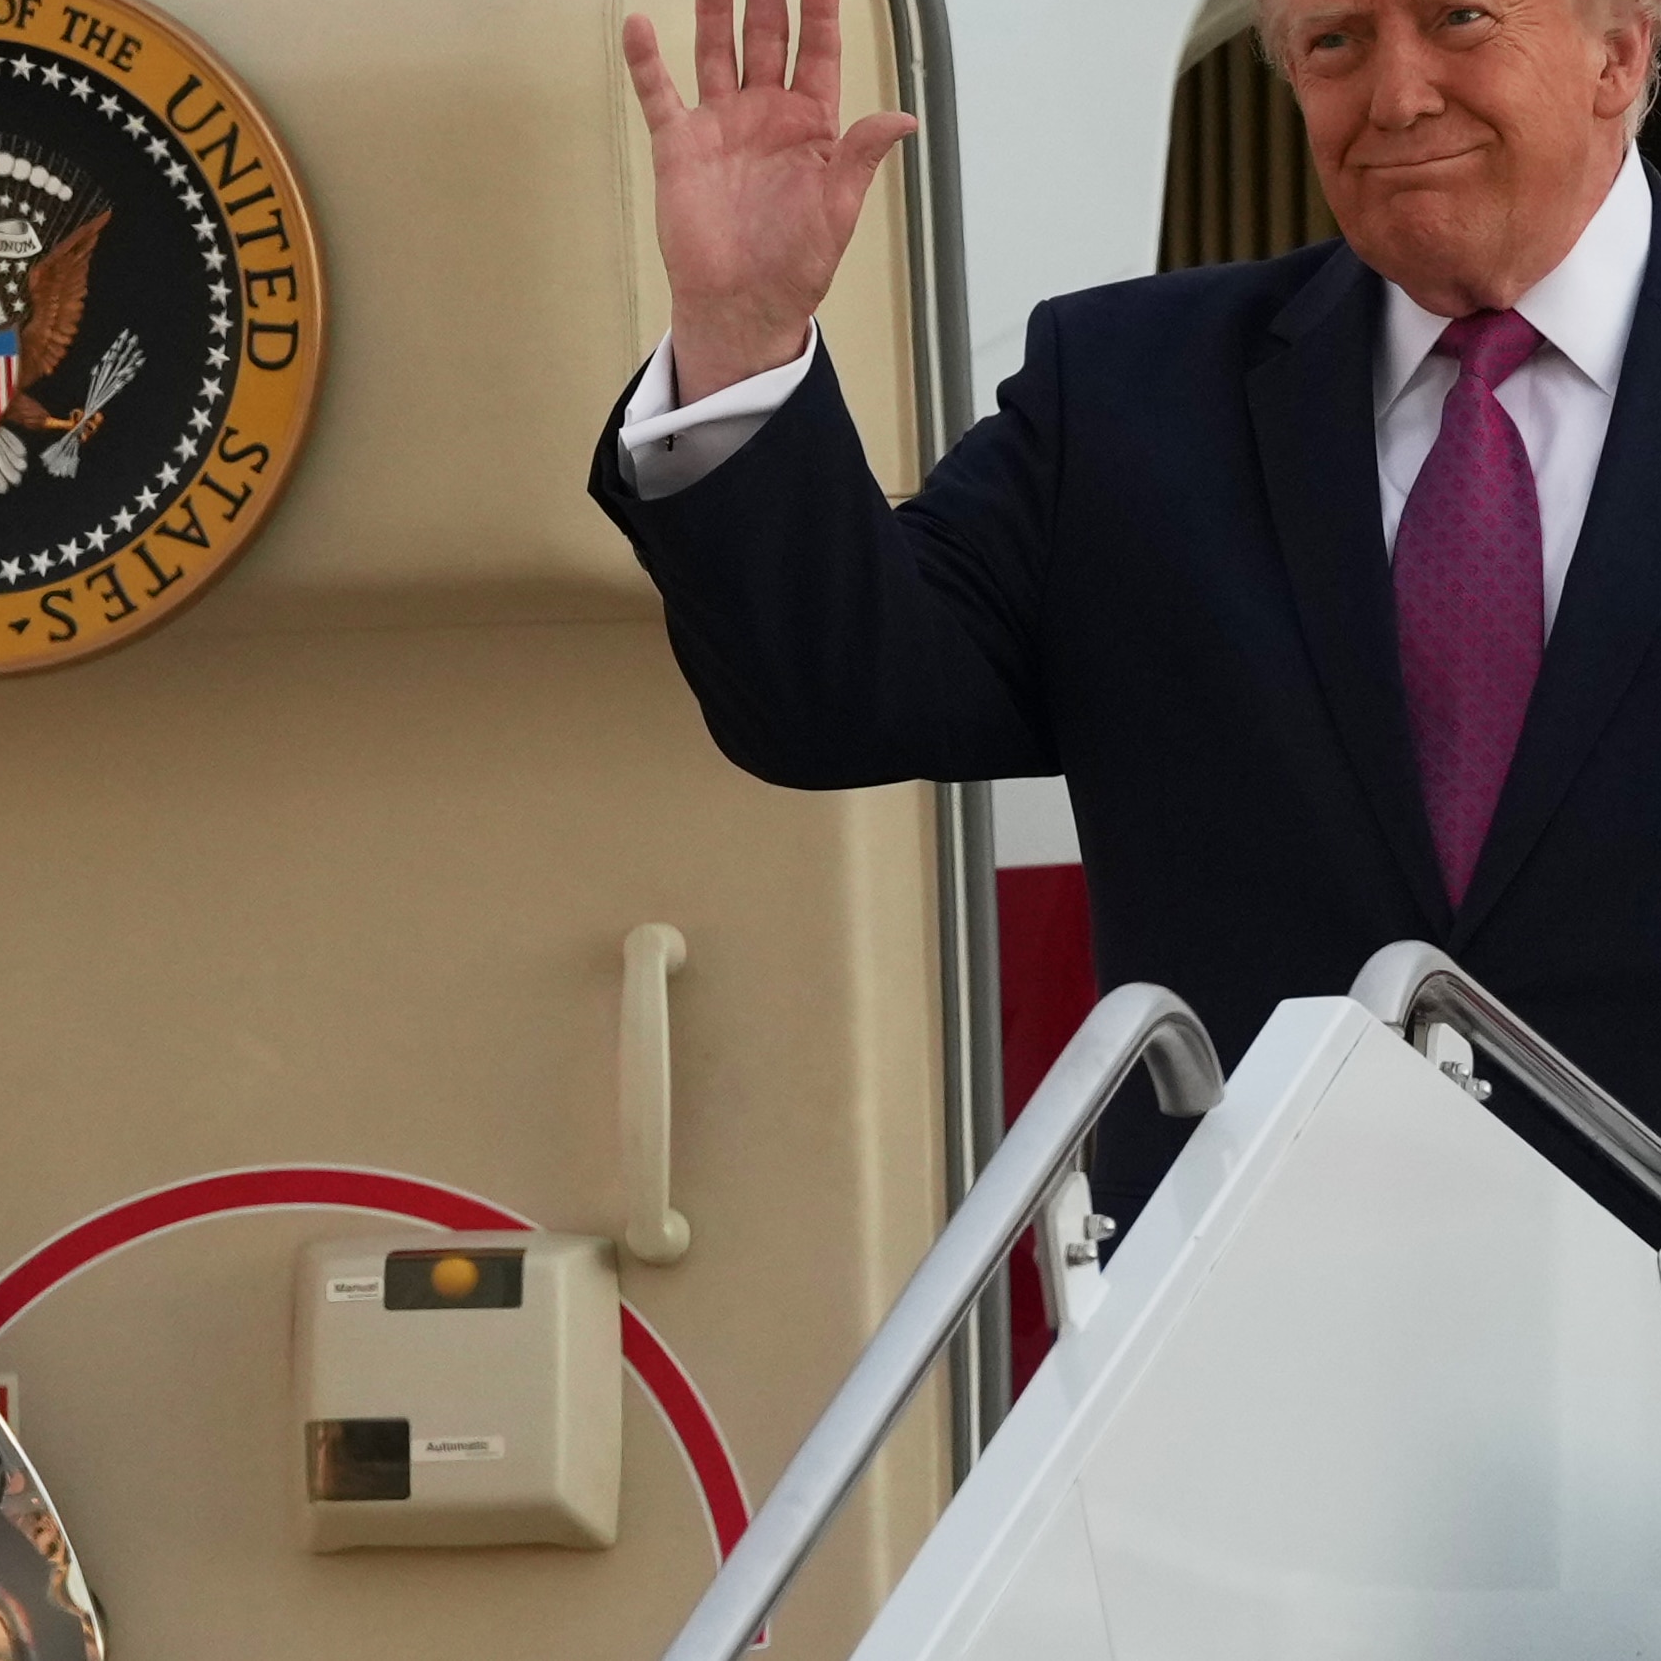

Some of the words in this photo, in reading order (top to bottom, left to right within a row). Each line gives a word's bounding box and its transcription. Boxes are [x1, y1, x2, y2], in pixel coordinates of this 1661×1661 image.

[62, 6, 143, 73] THE
[165, 74, 299, 372] UNITED
[39, 426, 270, 643] STATES
[425, 1441, 488, 1452] Automatic
